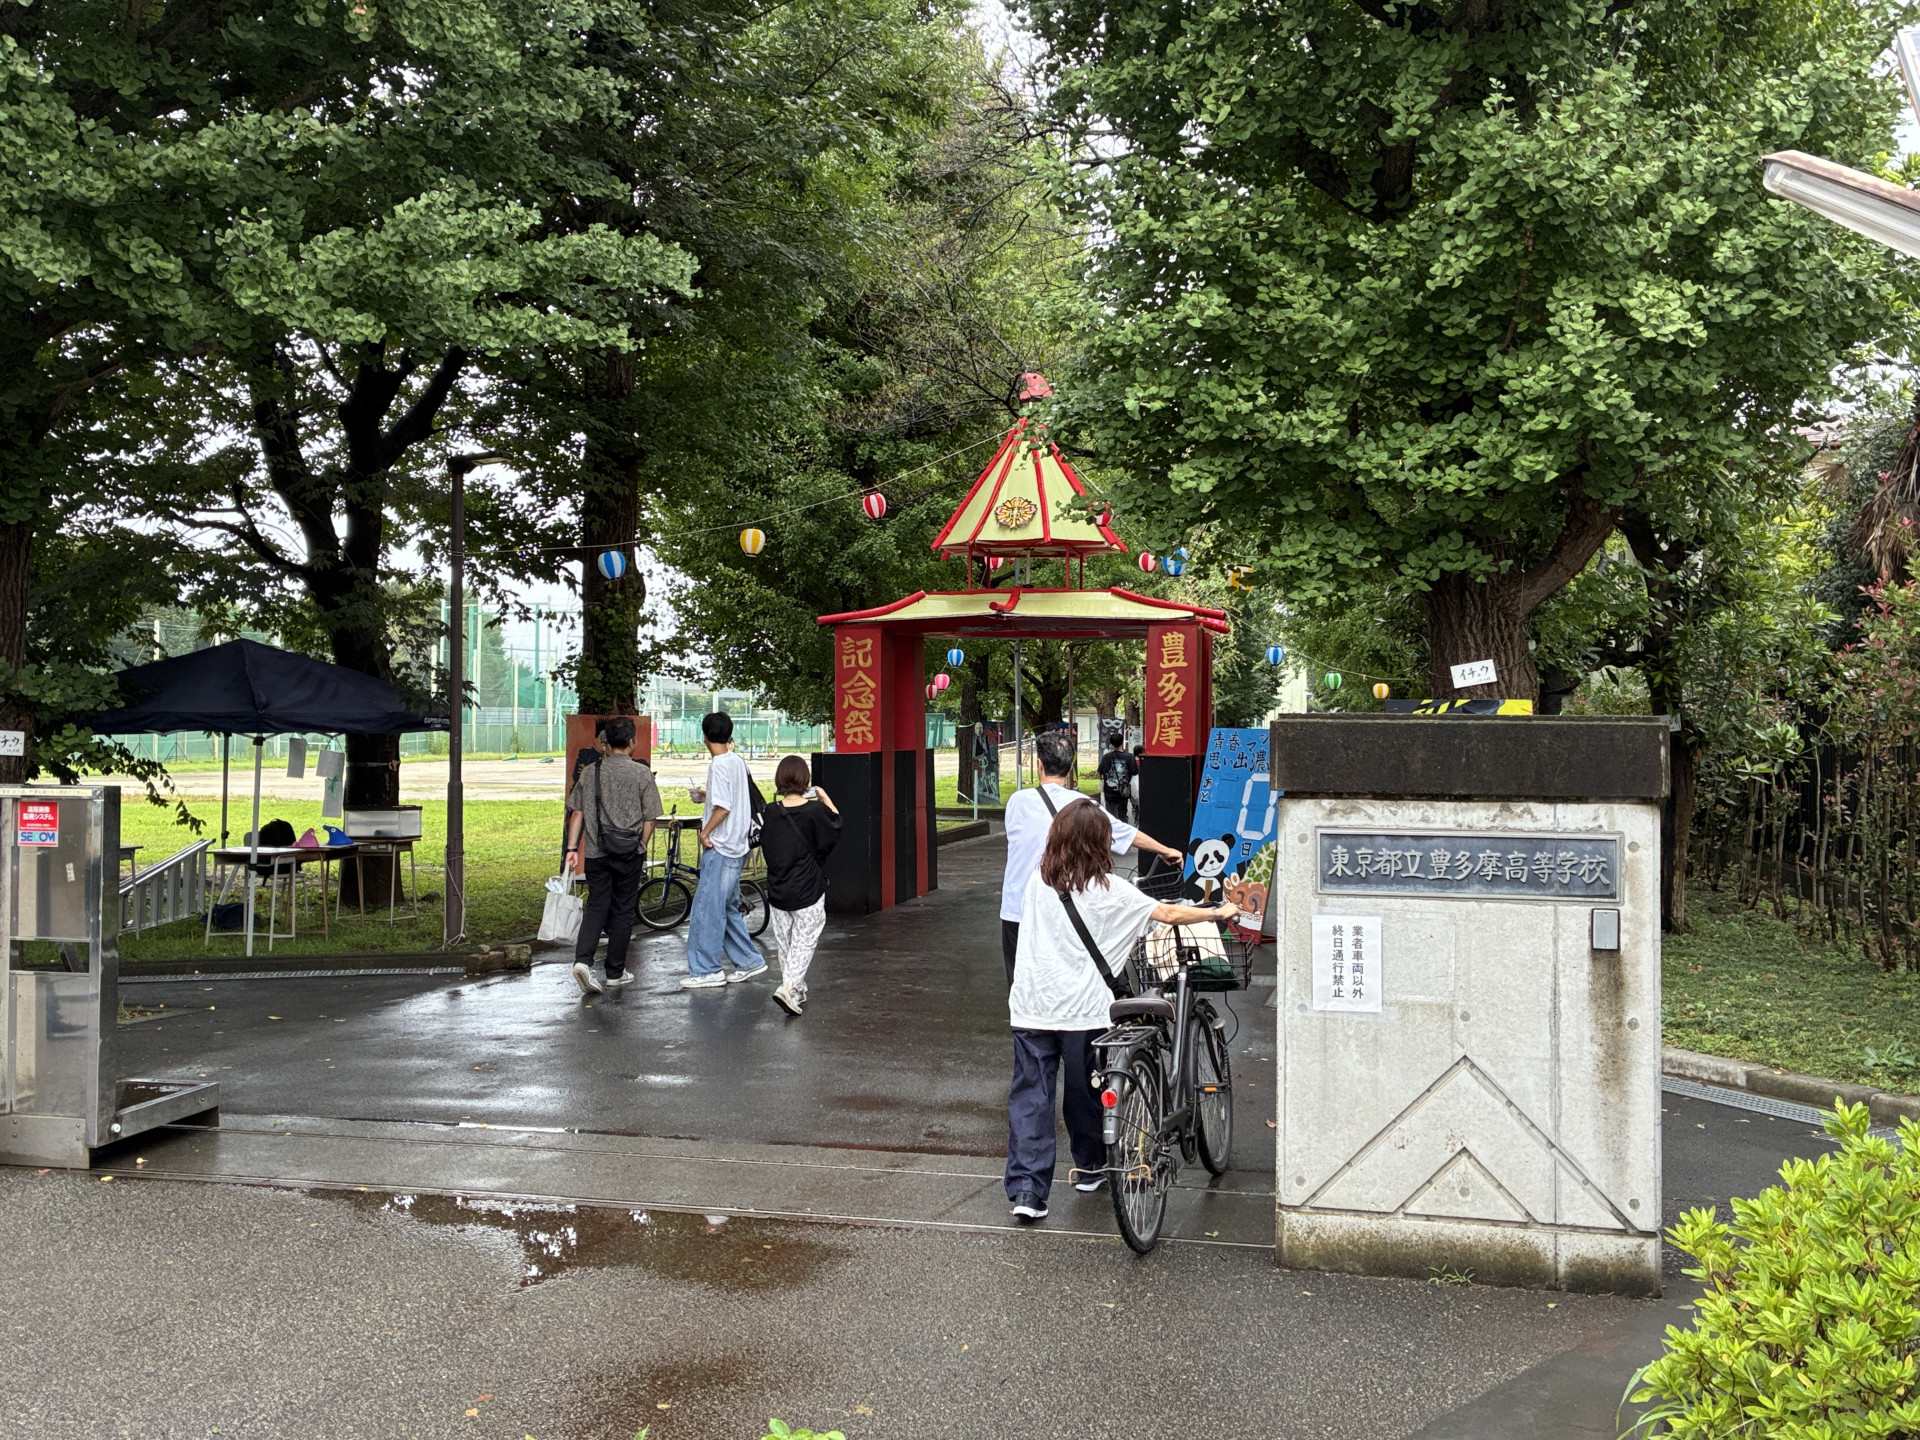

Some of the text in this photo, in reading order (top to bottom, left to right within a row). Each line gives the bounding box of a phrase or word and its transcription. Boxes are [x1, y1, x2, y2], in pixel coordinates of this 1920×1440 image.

[841, 636, 877, 745] 記念祭
[1151, 631, 1189, 748] 豊多摩
[1200, 776, 1214, 803] あと
[1236, 772, 1278, 841] 0
[20, 831, 56, 843] SECOM
[1241, 842, 1252, 857] 日
[1328, 844, 1611, 885] 東京都立豊多摩高等学校
[1332, 924, 1345, 998] 終日通行禁止
[1351, 924, 1364, 1000] 業者車両以外
